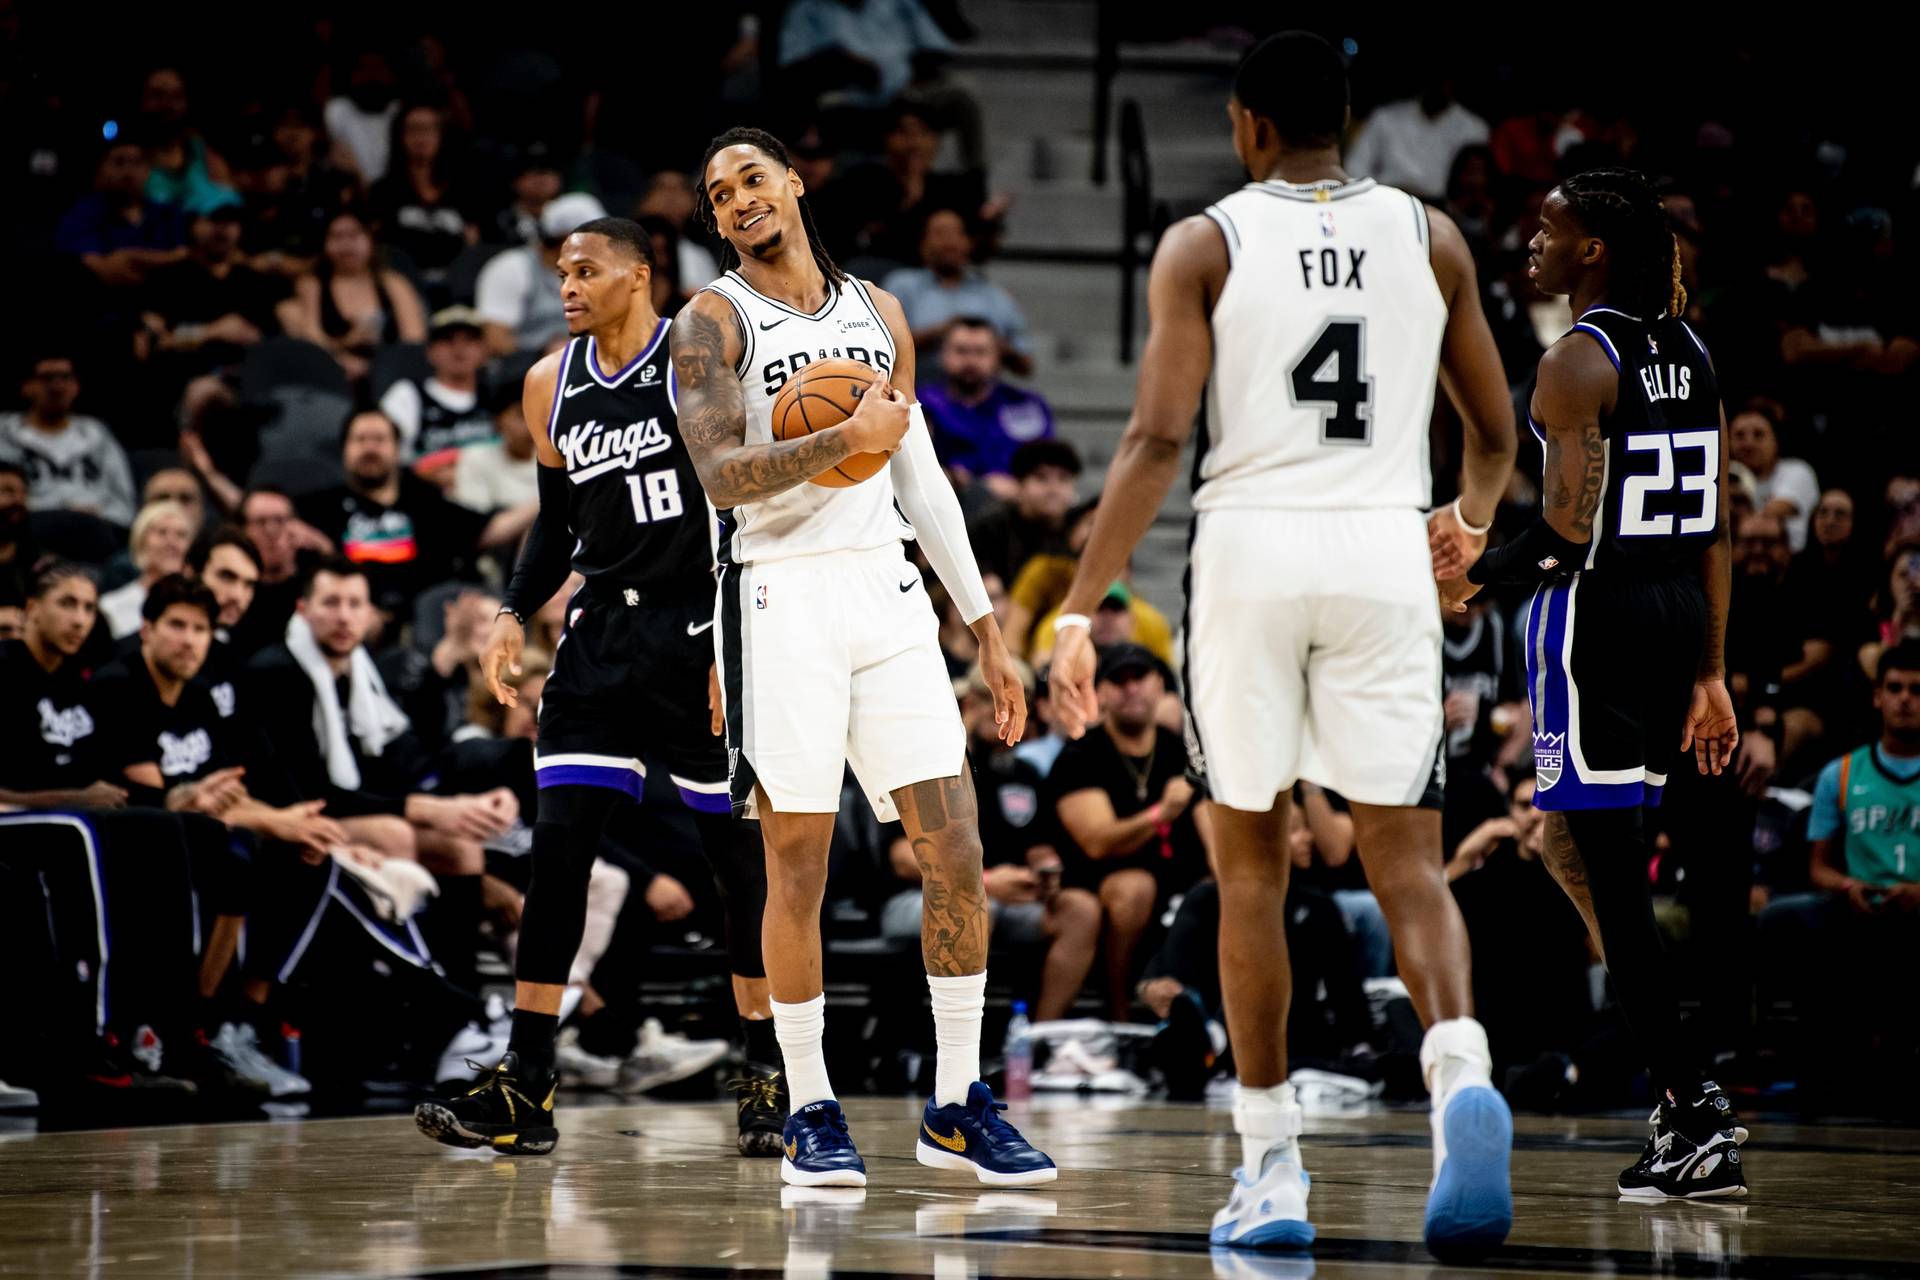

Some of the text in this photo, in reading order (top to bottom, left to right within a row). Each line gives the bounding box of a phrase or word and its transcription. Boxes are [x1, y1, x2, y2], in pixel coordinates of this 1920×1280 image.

[1298, 247, 1366, 290] FOX
[843, 321, 871, 330] LEDGER
[1286, 318, 1373, 446] 4
[1640, 364, 1691, 403] ELLIS
[557, 417, 672, 485] Kings
[625, 468, 684, 525] 18
[1618, 429, 1719, 537] 23
[1894, 843, 1906, 875] 1
[1699, 1165, 1706, 1177] 2
